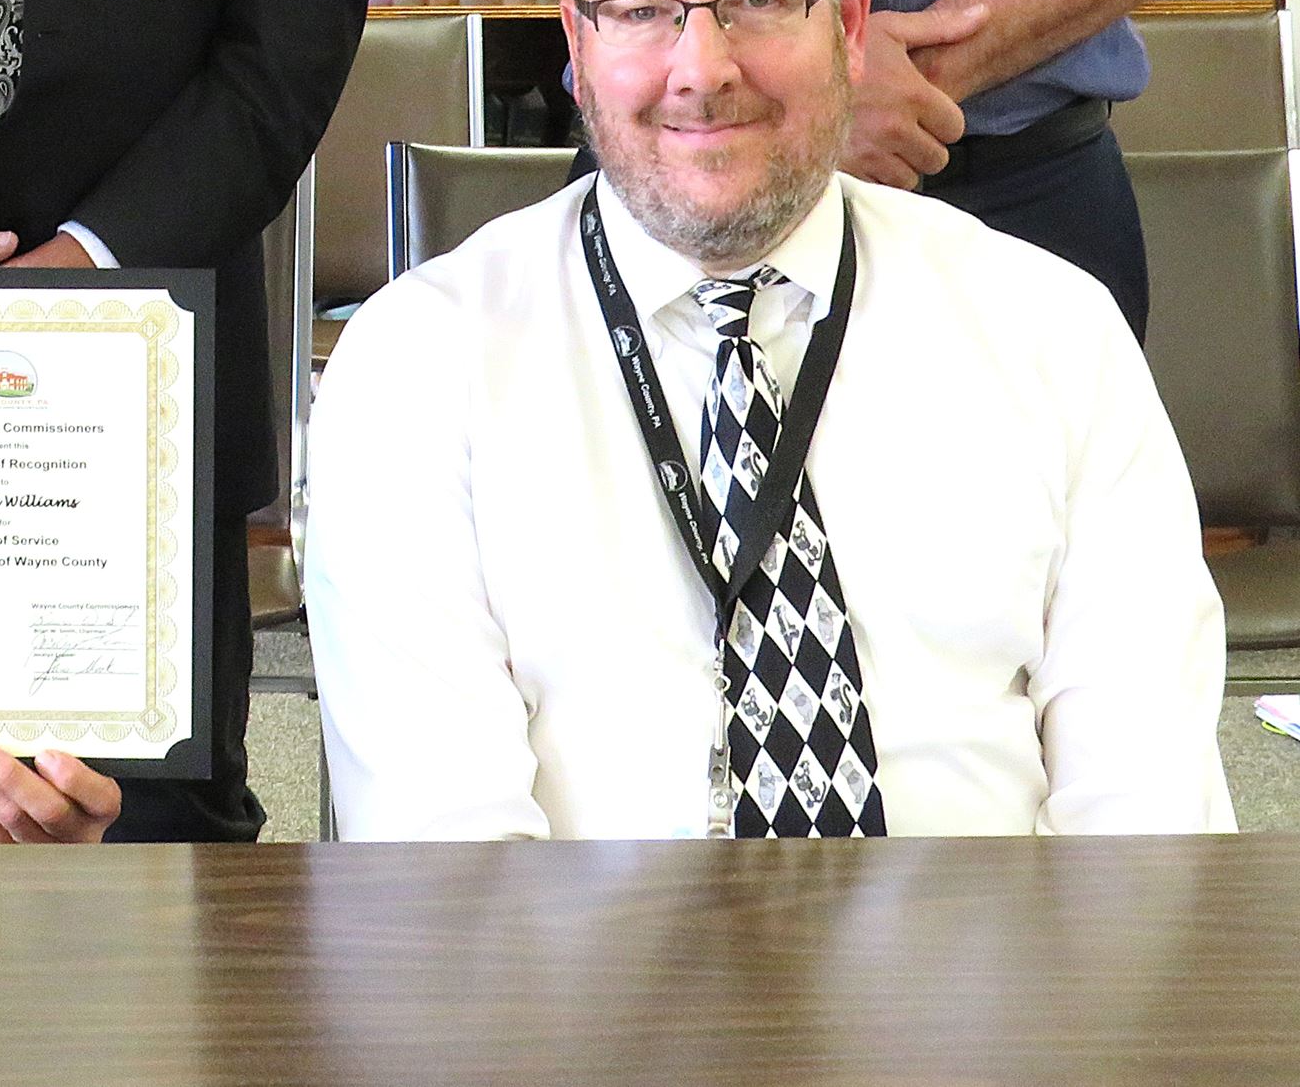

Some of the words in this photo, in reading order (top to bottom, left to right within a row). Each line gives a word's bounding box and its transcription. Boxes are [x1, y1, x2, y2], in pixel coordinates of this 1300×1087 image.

[631, 355, 646, 383] Wayne
[651, 415, 662, 429] PA
[3, 421, 104, 434] Commissioners
[13, 442, 29, 450] this
[9, 458, 87, 472] Recognition
[0, 478, 10, 486] to
[4, 494, 80, 509] Williams
[0, 518, 11, 527] for
[11, 535, 59, 546] Service
[14, 556, 58, 569] Wayne
[61, 556, 108, 569] County
[31, 602, 57, 611] Wayne
[58, 602, 84, 611] County
[85, 602, 140, 611] Commissioners
